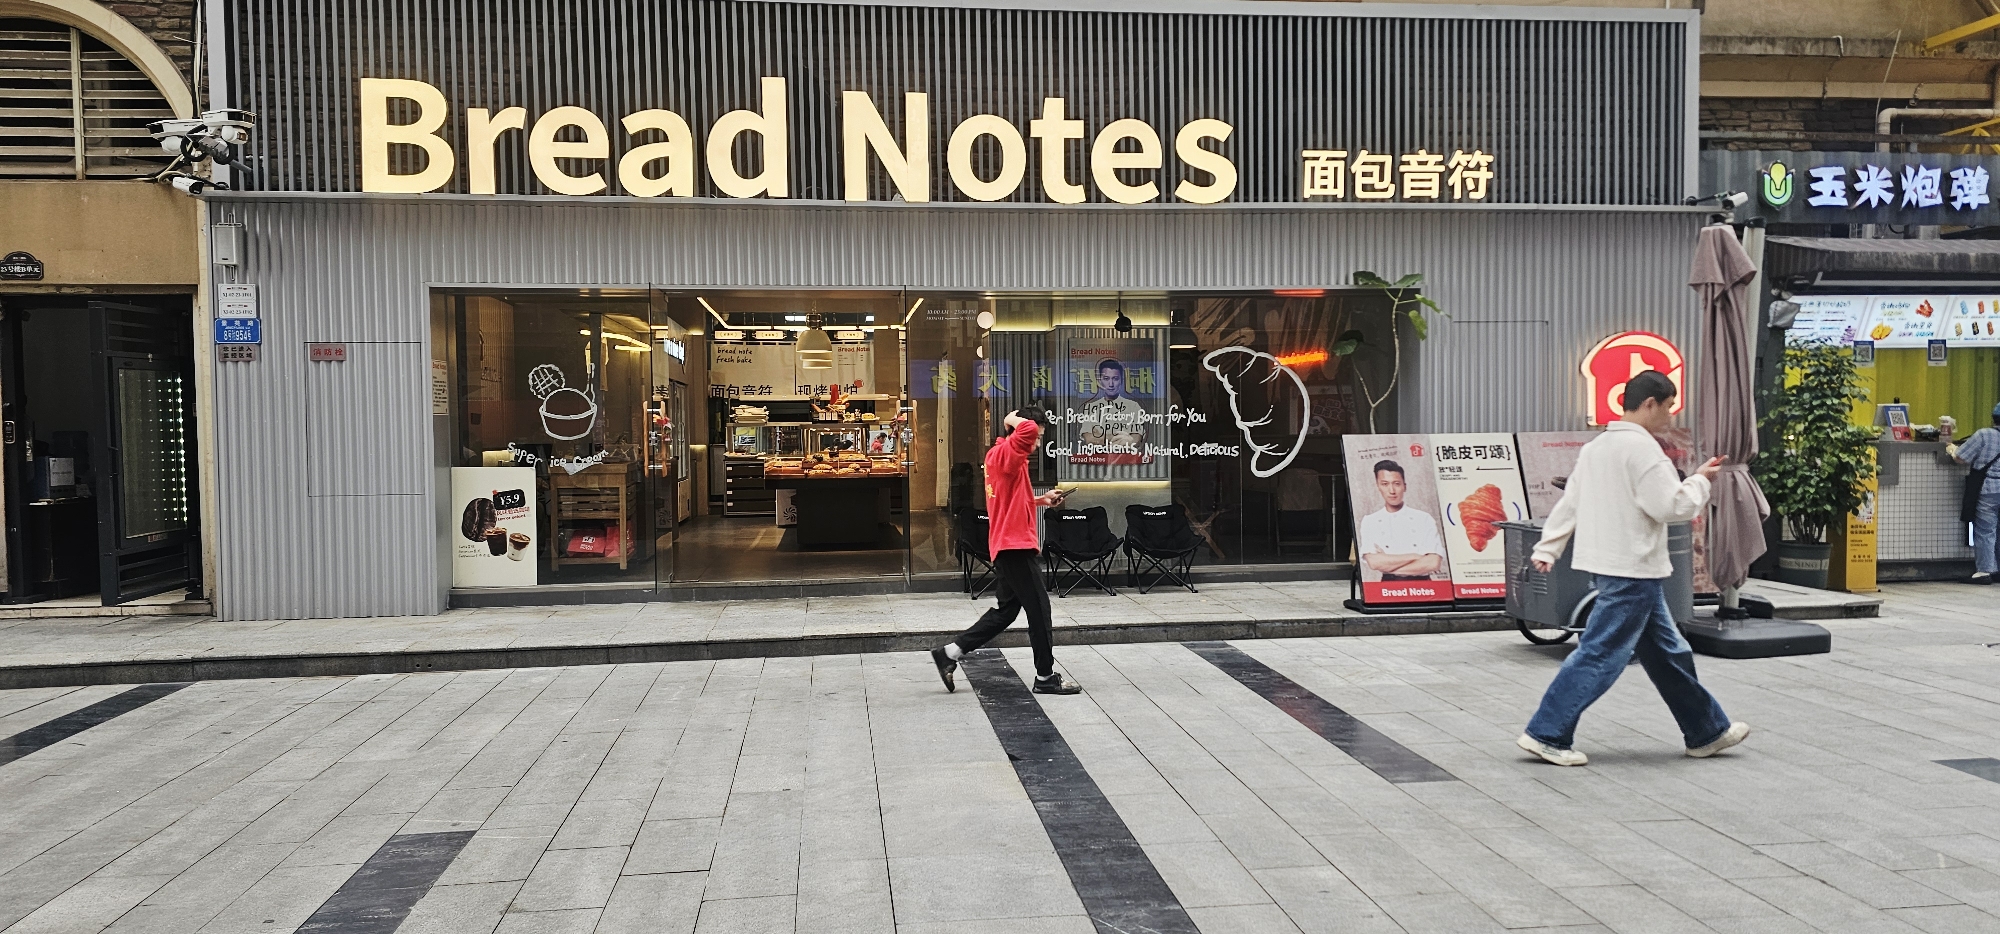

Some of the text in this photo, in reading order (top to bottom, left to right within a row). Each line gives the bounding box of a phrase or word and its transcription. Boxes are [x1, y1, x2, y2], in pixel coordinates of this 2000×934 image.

[360, 76, 1238, 204] Bread Notes
[1302, 149, 1495, 201] 面包音符
[1807, 163, 1990, 212] 玉米炮弹
[314, 348, 343, 356] 消防栓
[717, 347, 736, 355] bread
[1071, 347, 1117, 356] Bread Notes
[716, 356, 735, 364] fresh
[711, 384, 773, 398] 面包音符
[1066, 407, 1098, 425] Bread
[1100, 404, 1135, 427] Factory
[1138, 409, 1164, 426] Born
[1165, 404, 1187, 427] for
[1187, 408, 1207, 426] You
[507, 442, 609, 469] Super ice Cream
[1046, 440, 1240, 459] Good Ingredients, Natural, Delicious
[1435, 444, 1511, 462] {脆皮可颂}
[499, 493, 520, 506] ¥5.9
[1382, 587, 1435, 597] Bread Notes
[1461, 587, 1480, 595] Bread
[1481, 587, 1500, 595] Notes
